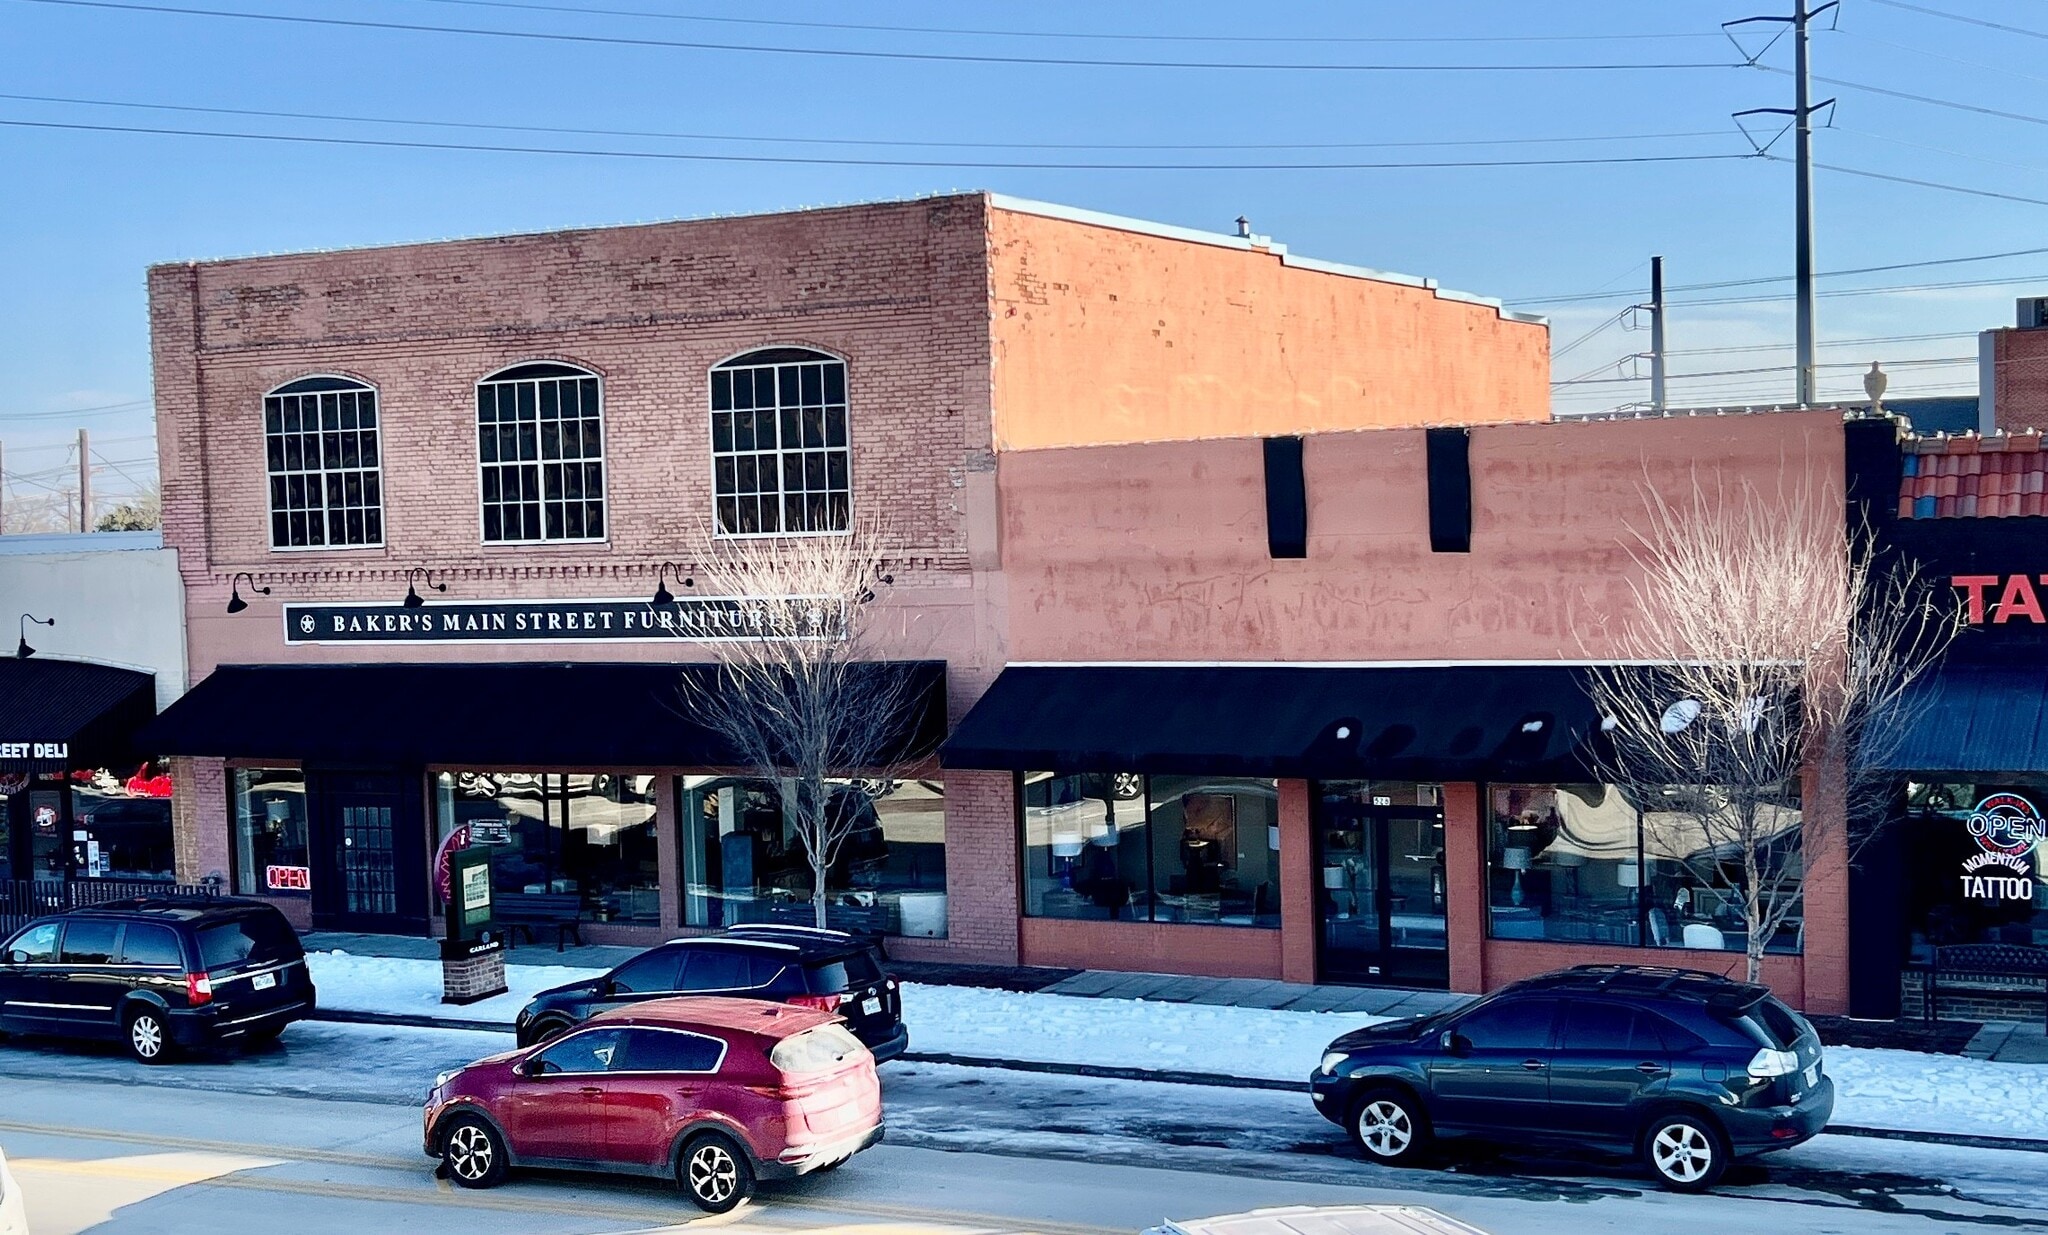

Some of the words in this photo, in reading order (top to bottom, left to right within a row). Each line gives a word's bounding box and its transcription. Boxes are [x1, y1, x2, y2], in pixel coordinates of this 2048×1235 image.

[333, 614, 433, 632] BAKER'S
[443, 613, 506, 631] MAIN
[515, 611, 614, 630] STREET
[33, 742, 69, 758] DELI
[1966, 813, 2046, 842] OPEN
[1961, 851, 2031, 875] MOMENTUM
[268, 867, 309, 889] OPEN
[1960, 875, 2033, 900] TATTOO
